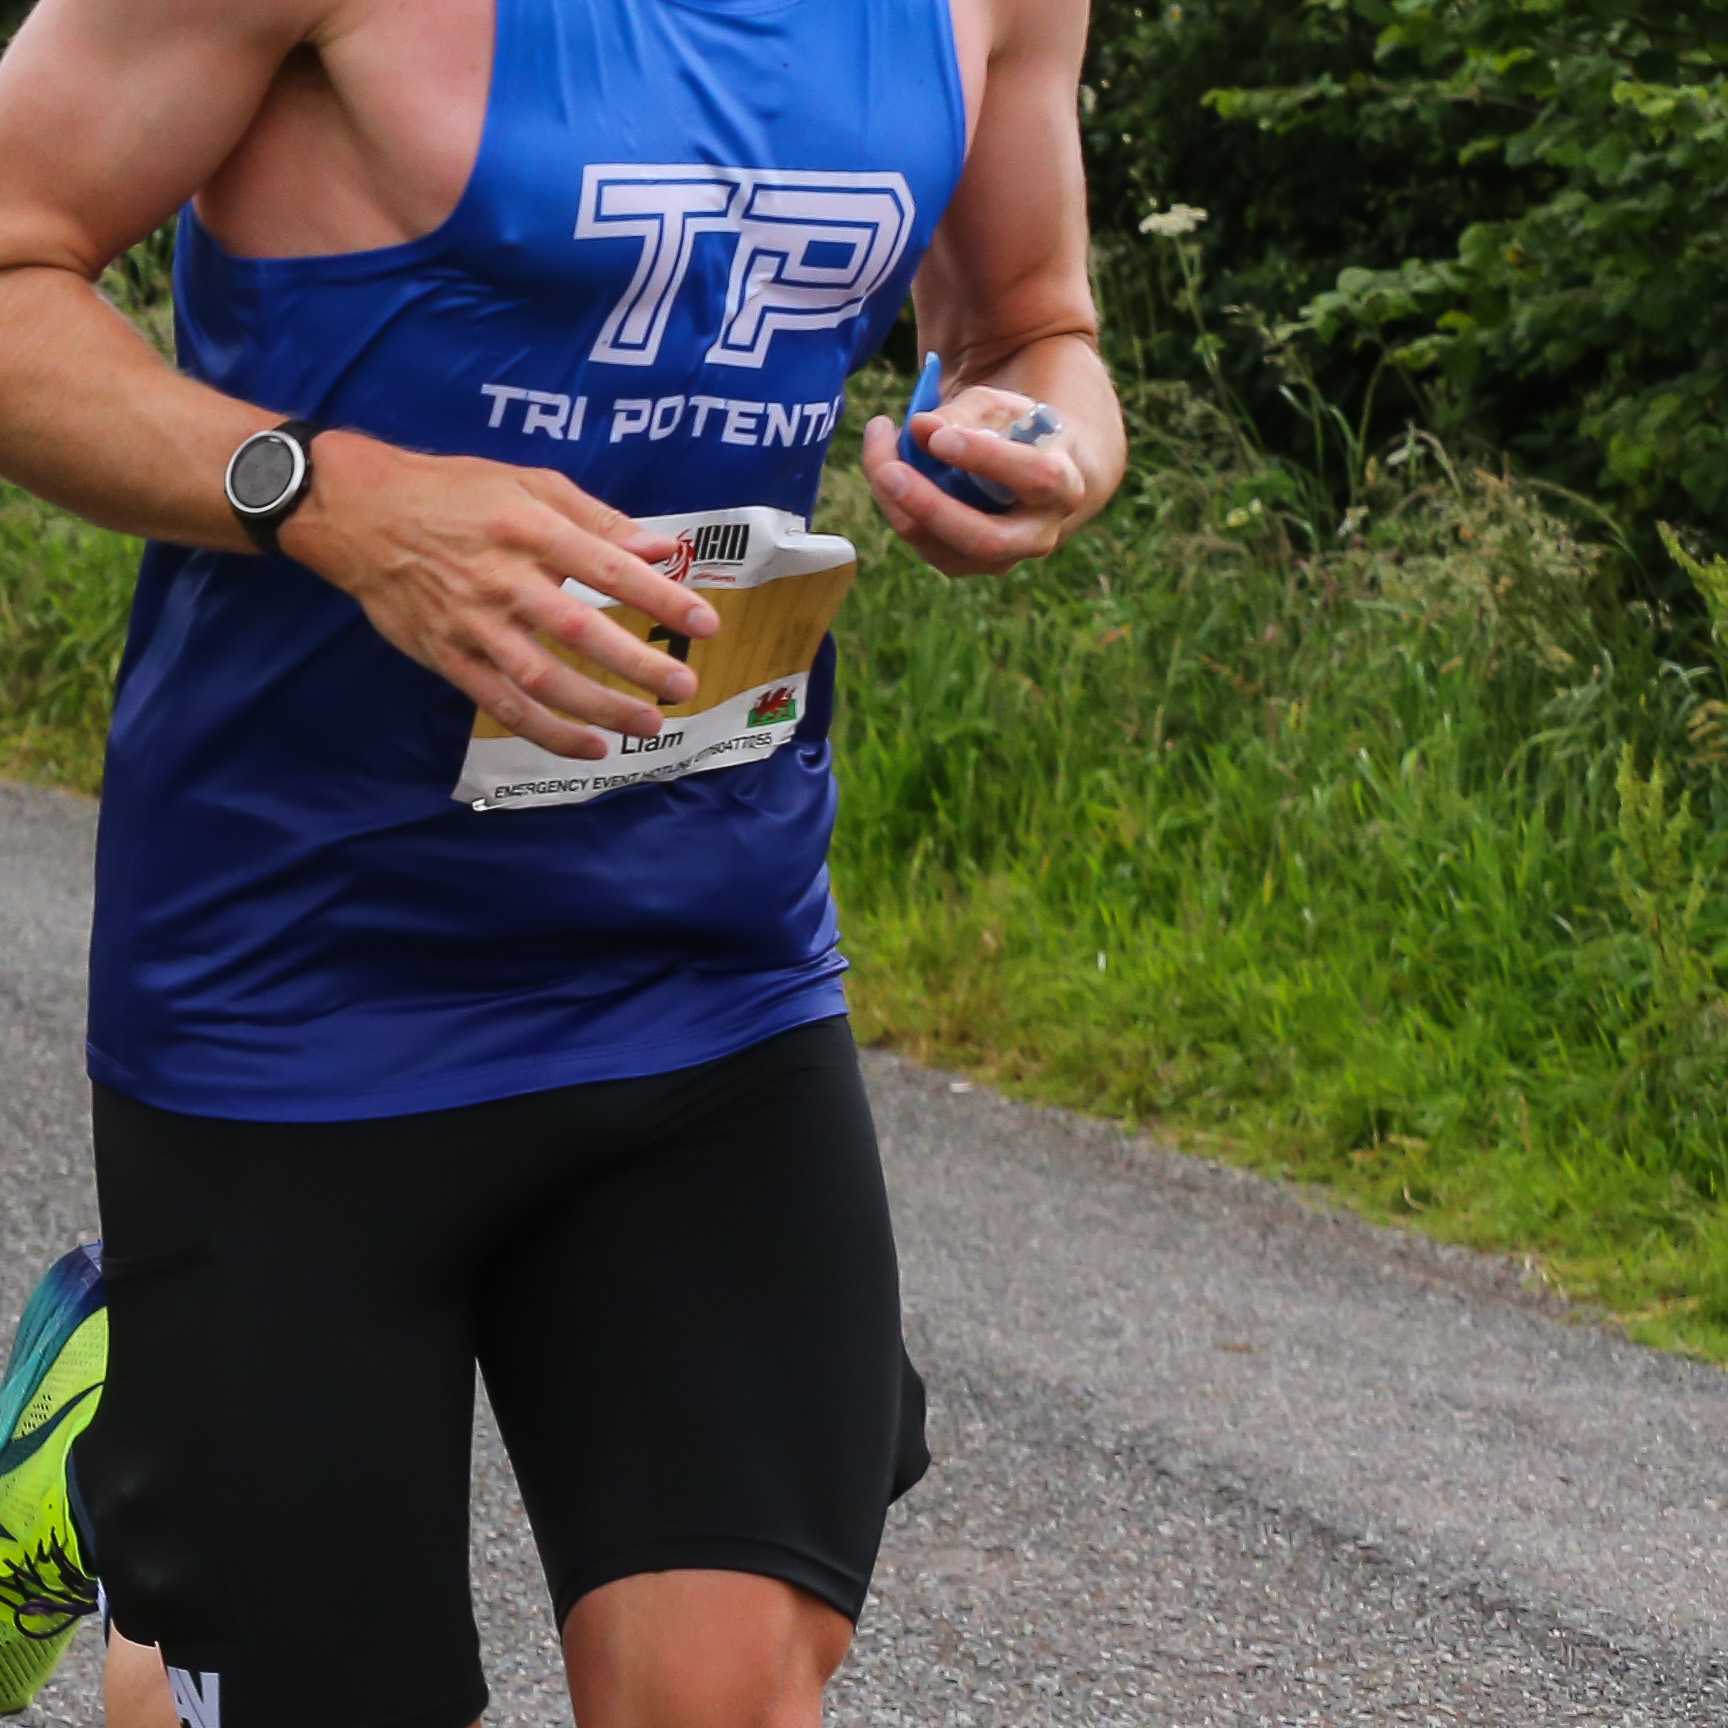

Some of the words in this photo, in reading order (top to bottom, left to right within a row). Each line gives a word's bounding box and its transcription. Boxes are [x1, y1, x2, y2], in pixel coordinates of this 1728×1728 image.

[574, 162, 916, 369] TP
[481, 383, 587, 441] TRI
[620, 730, 684, 755] Liam
